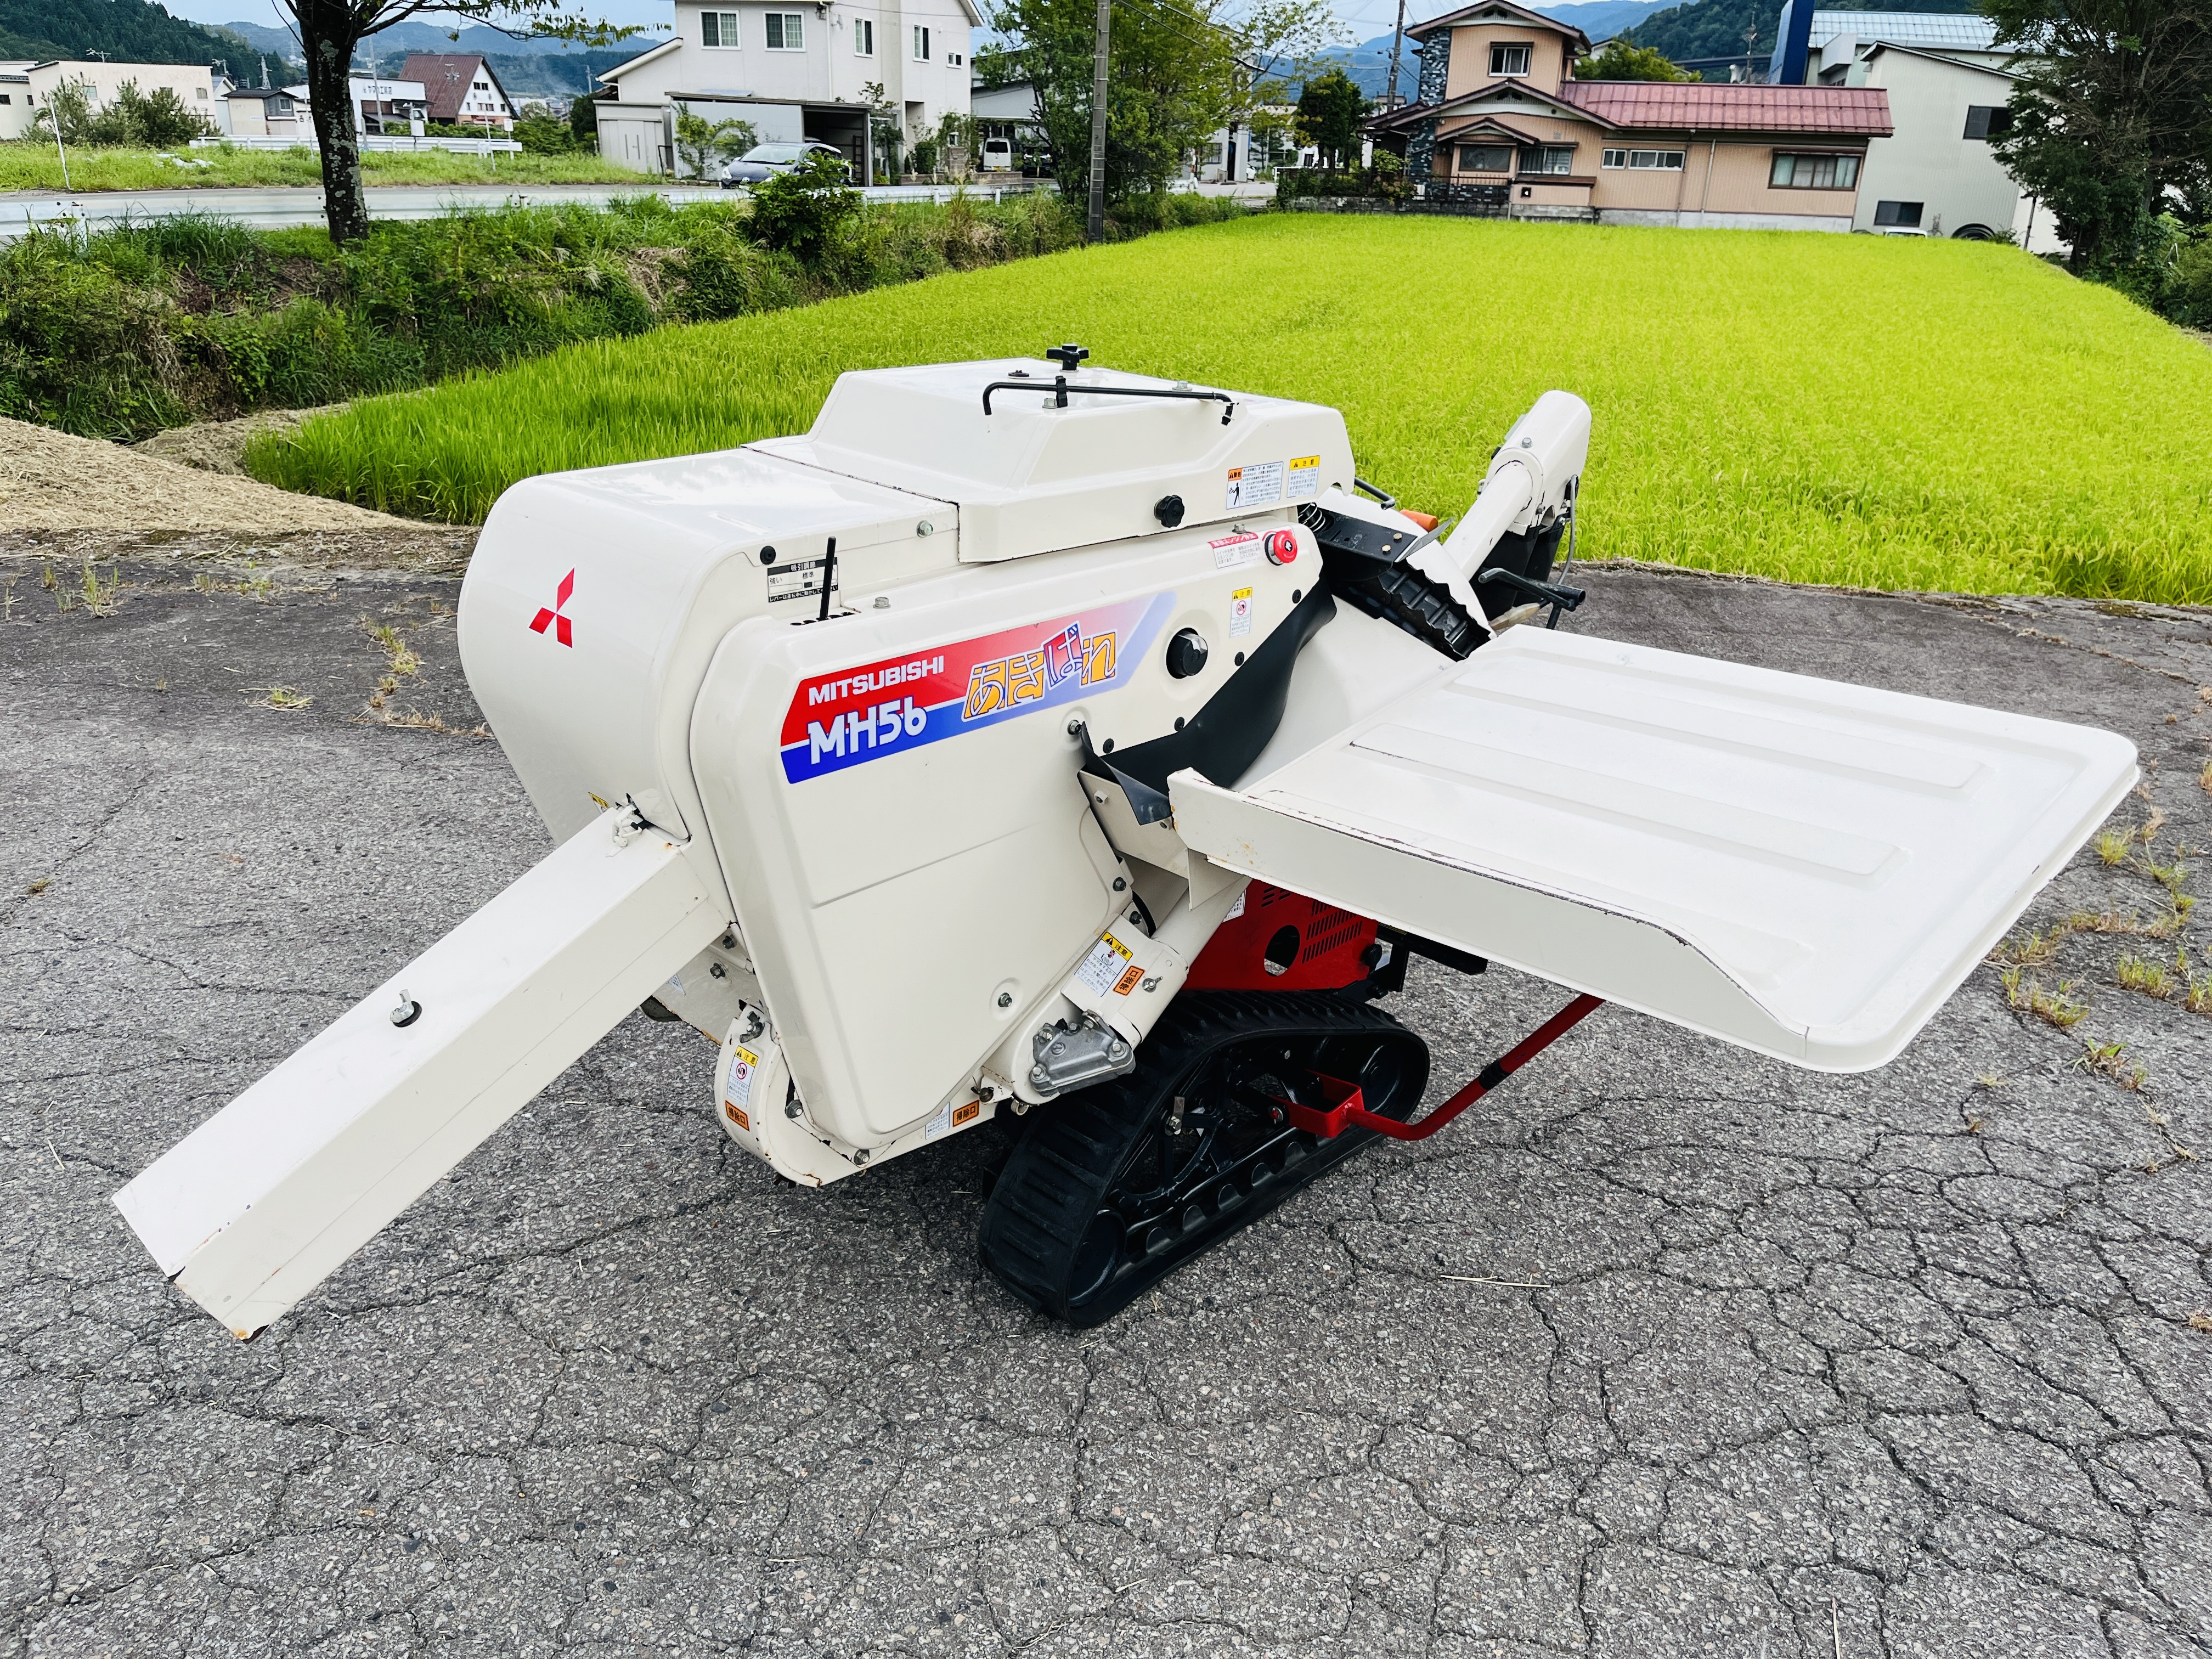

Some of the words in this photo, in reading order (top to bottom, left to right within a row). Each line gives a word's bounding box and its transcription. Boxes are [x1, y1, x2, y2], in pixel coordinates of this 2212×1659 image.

[791, 561, 816, 571] 吸引調節
[802, 571, 814, 579] 標準
[809, 655, 944, 706] MITSUBISHI
[808, 696, 927, 765] MH56
[1114, 943, 1128, 956] 注意
[1119, 970, 1139, 991] 掃除口
[743, 1053, 757, 1064] 注意
[728, 1107, 745, 1125] 掃除口
[956, 1105, 976, 1122] 掃除口
